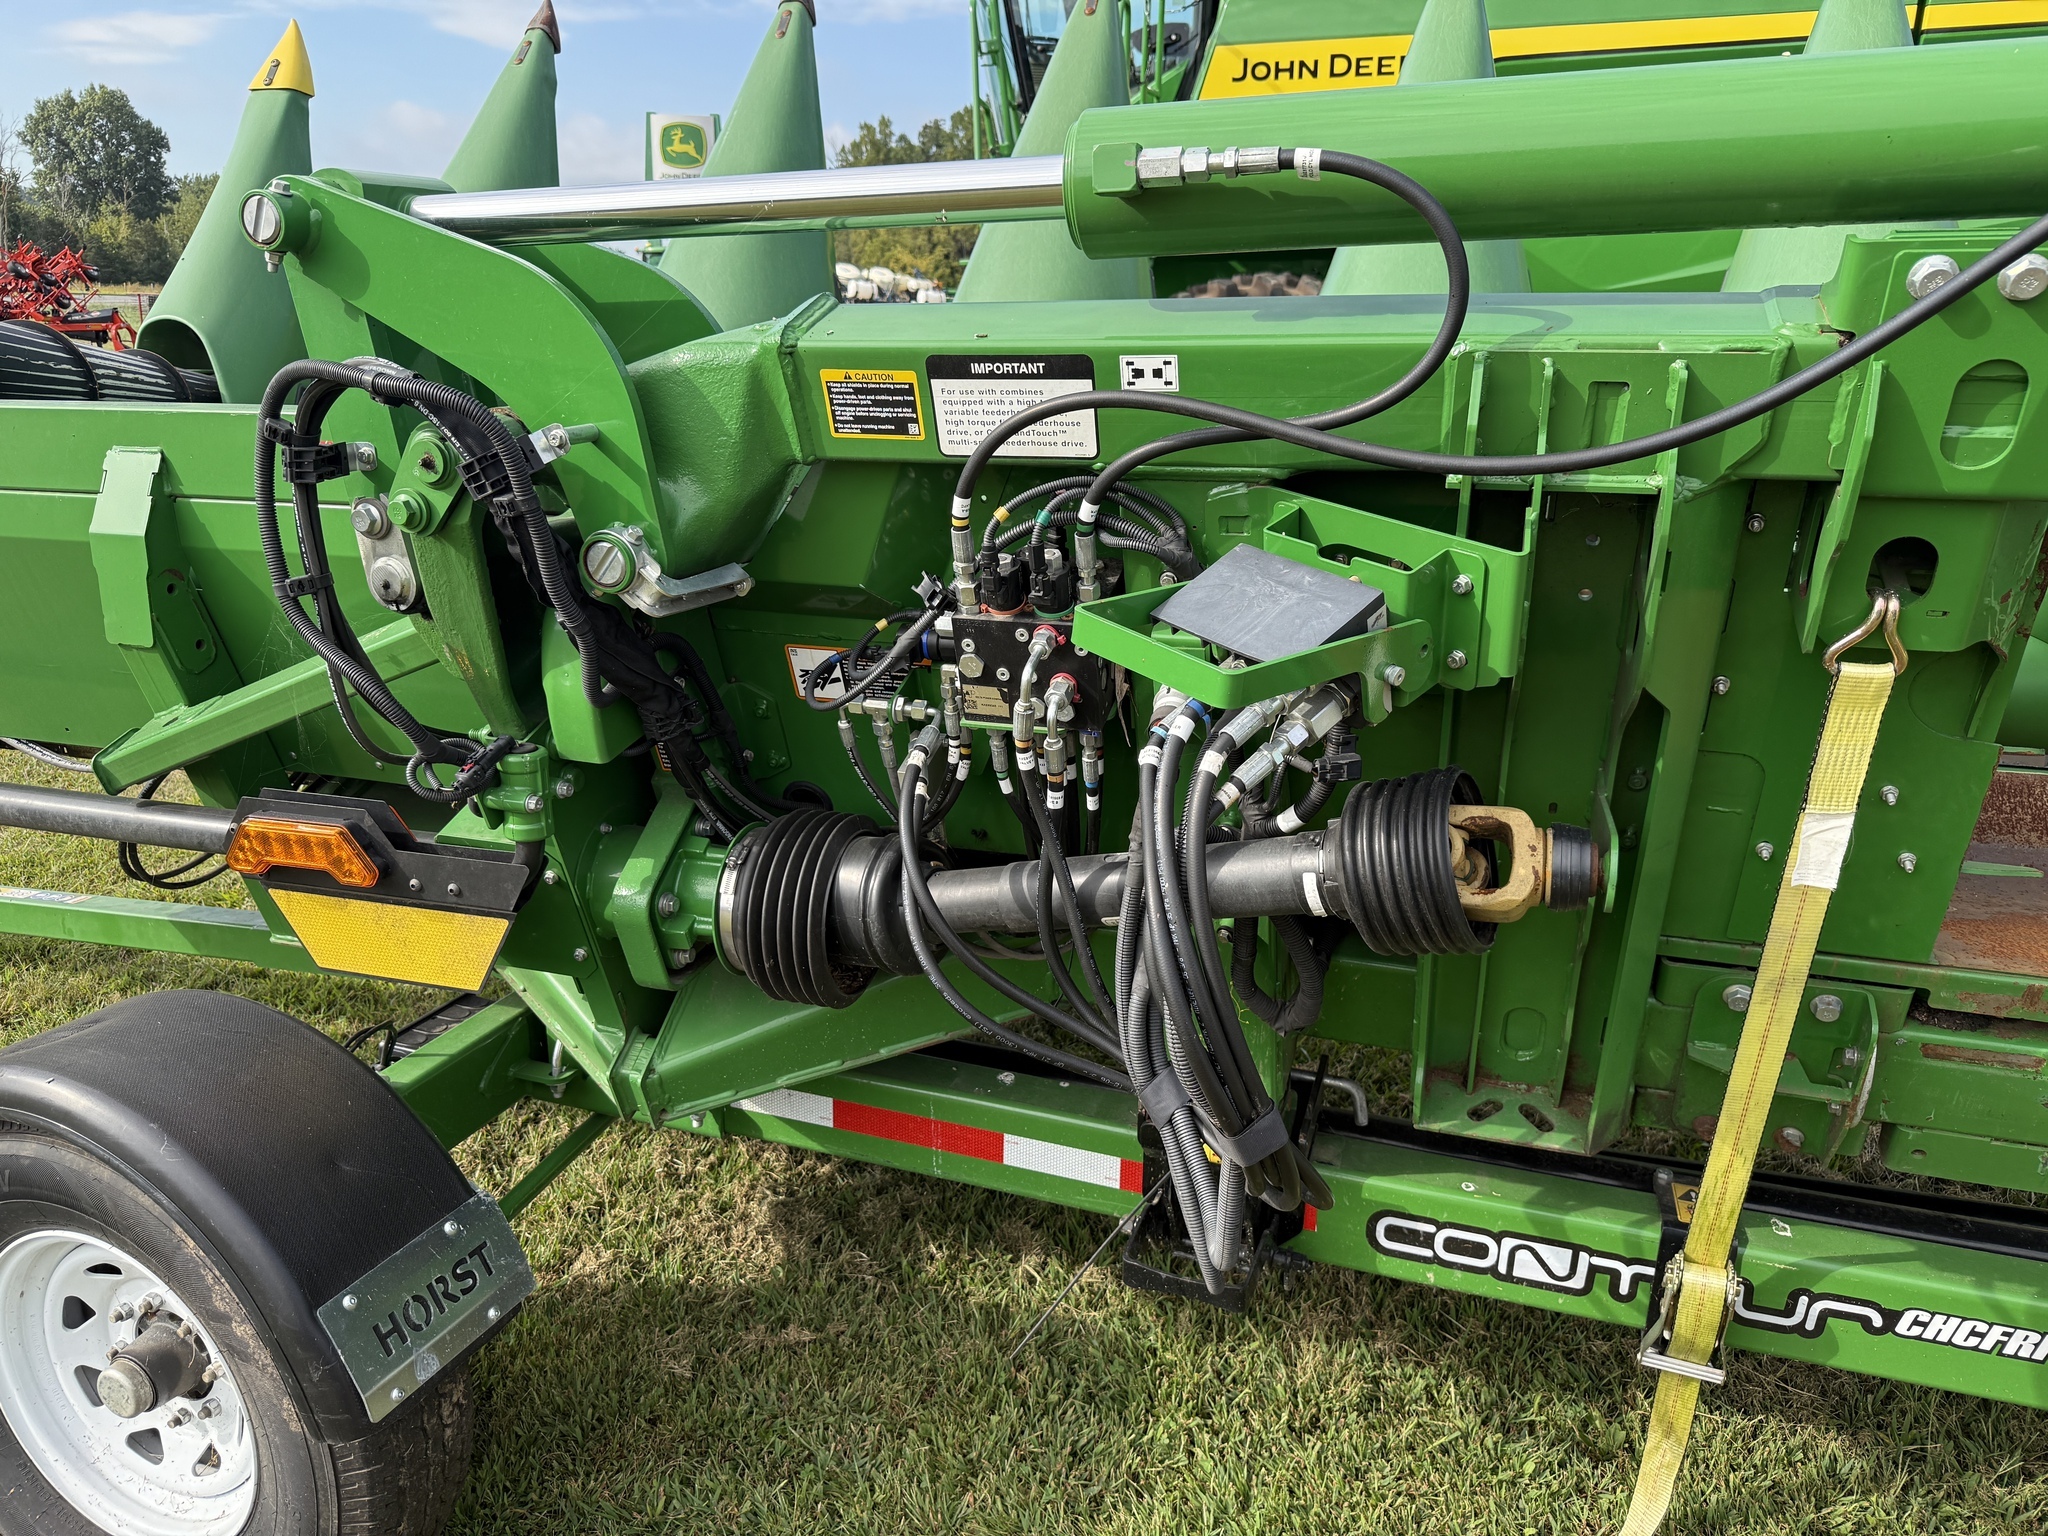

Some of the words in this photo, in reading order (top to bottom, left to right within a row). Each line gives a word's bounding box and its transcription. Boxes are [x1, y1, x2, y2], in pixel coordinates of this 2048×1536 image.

[1232, 57, 1318, 83] JOHN
[970, 362, 1045, 374] IMPORTANT
[942, 398, 984, 407] equipped
[943, 992, 972, 1020] exceeds
[372, 1240, 496, 1359] HORST
